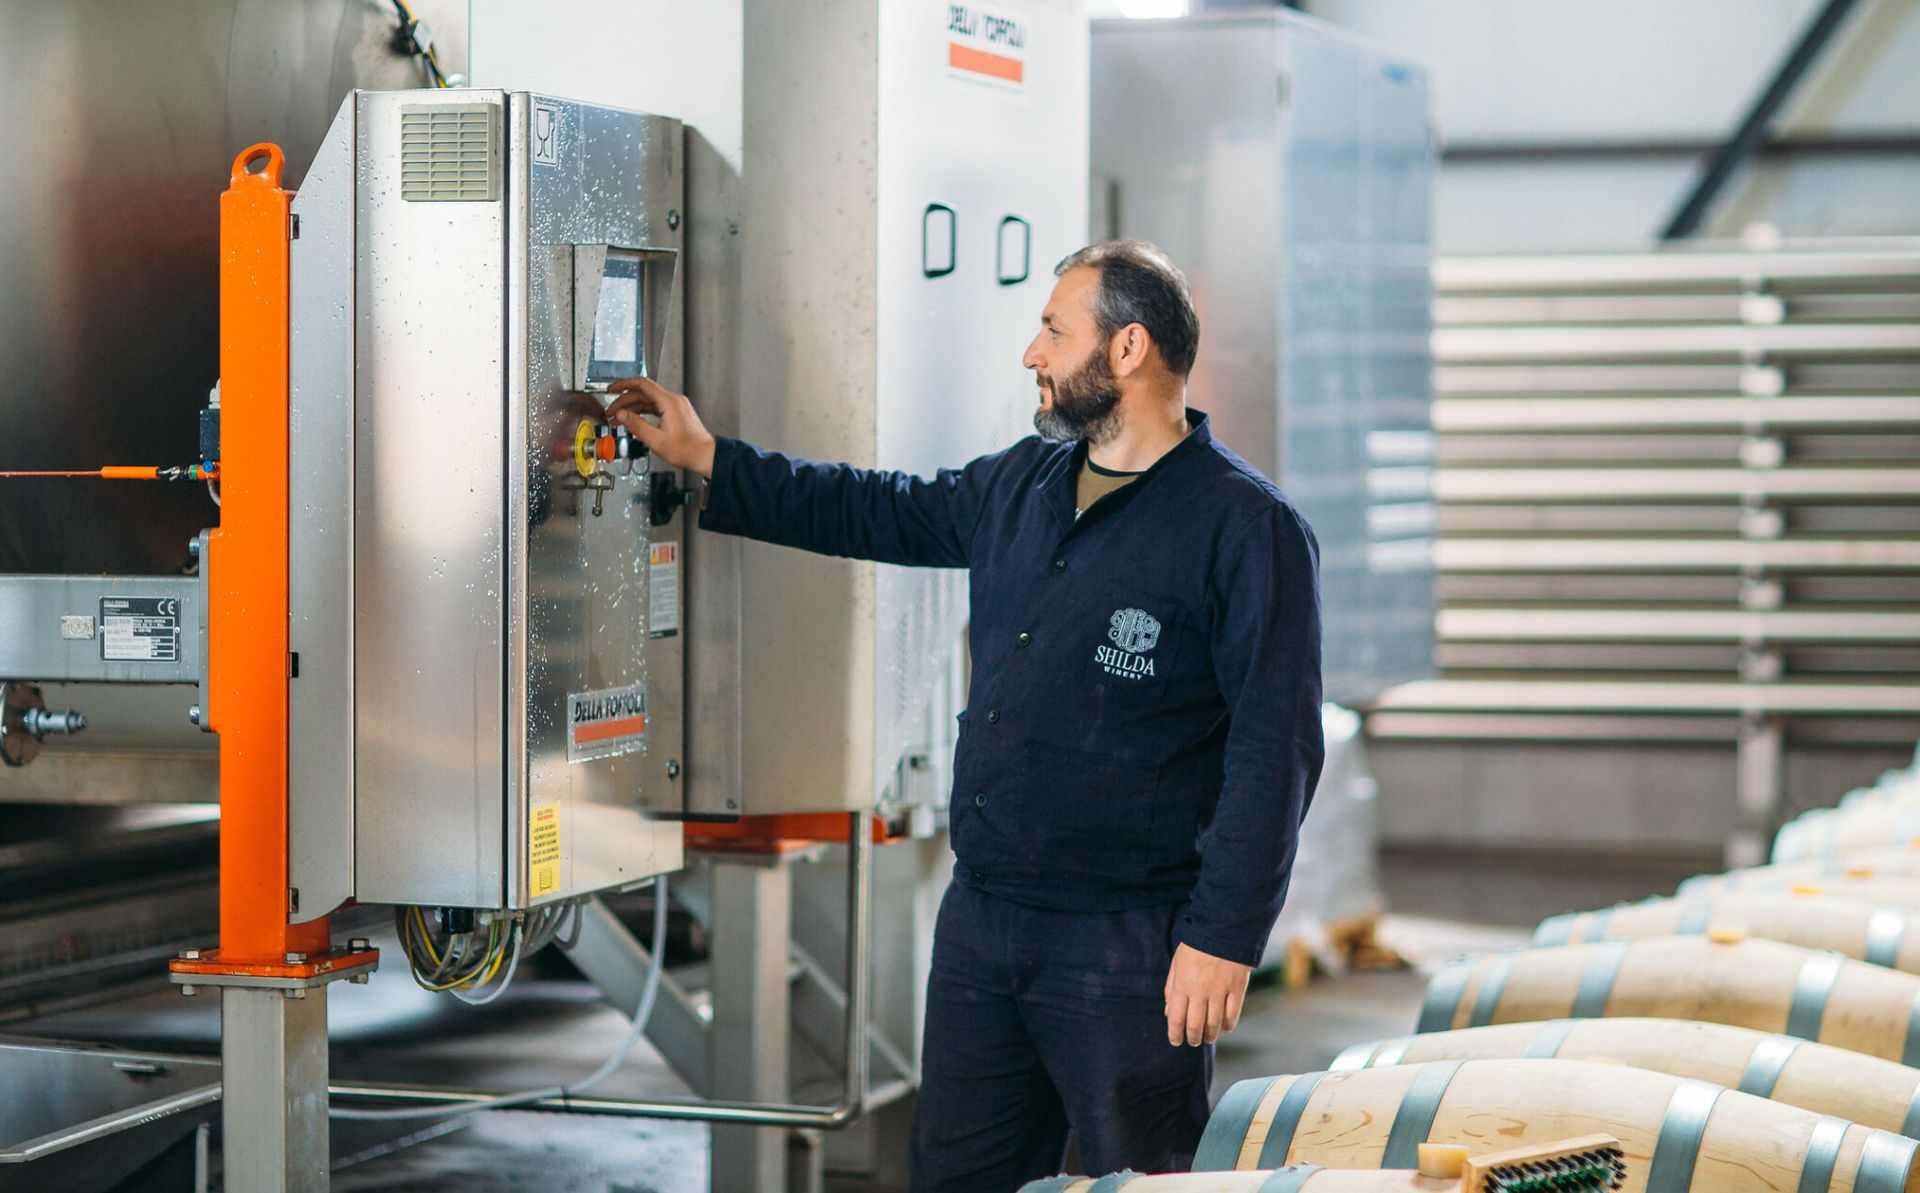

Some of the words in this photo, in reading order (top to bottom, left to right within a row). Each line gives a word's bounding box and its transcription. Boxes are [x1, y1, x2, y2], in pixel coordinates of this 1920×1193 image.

[1095, 645, 1155, 676] SHILDA
[1104, 665, 1142, 681] WINERY
[575, 699, 602, 722] DELLA
